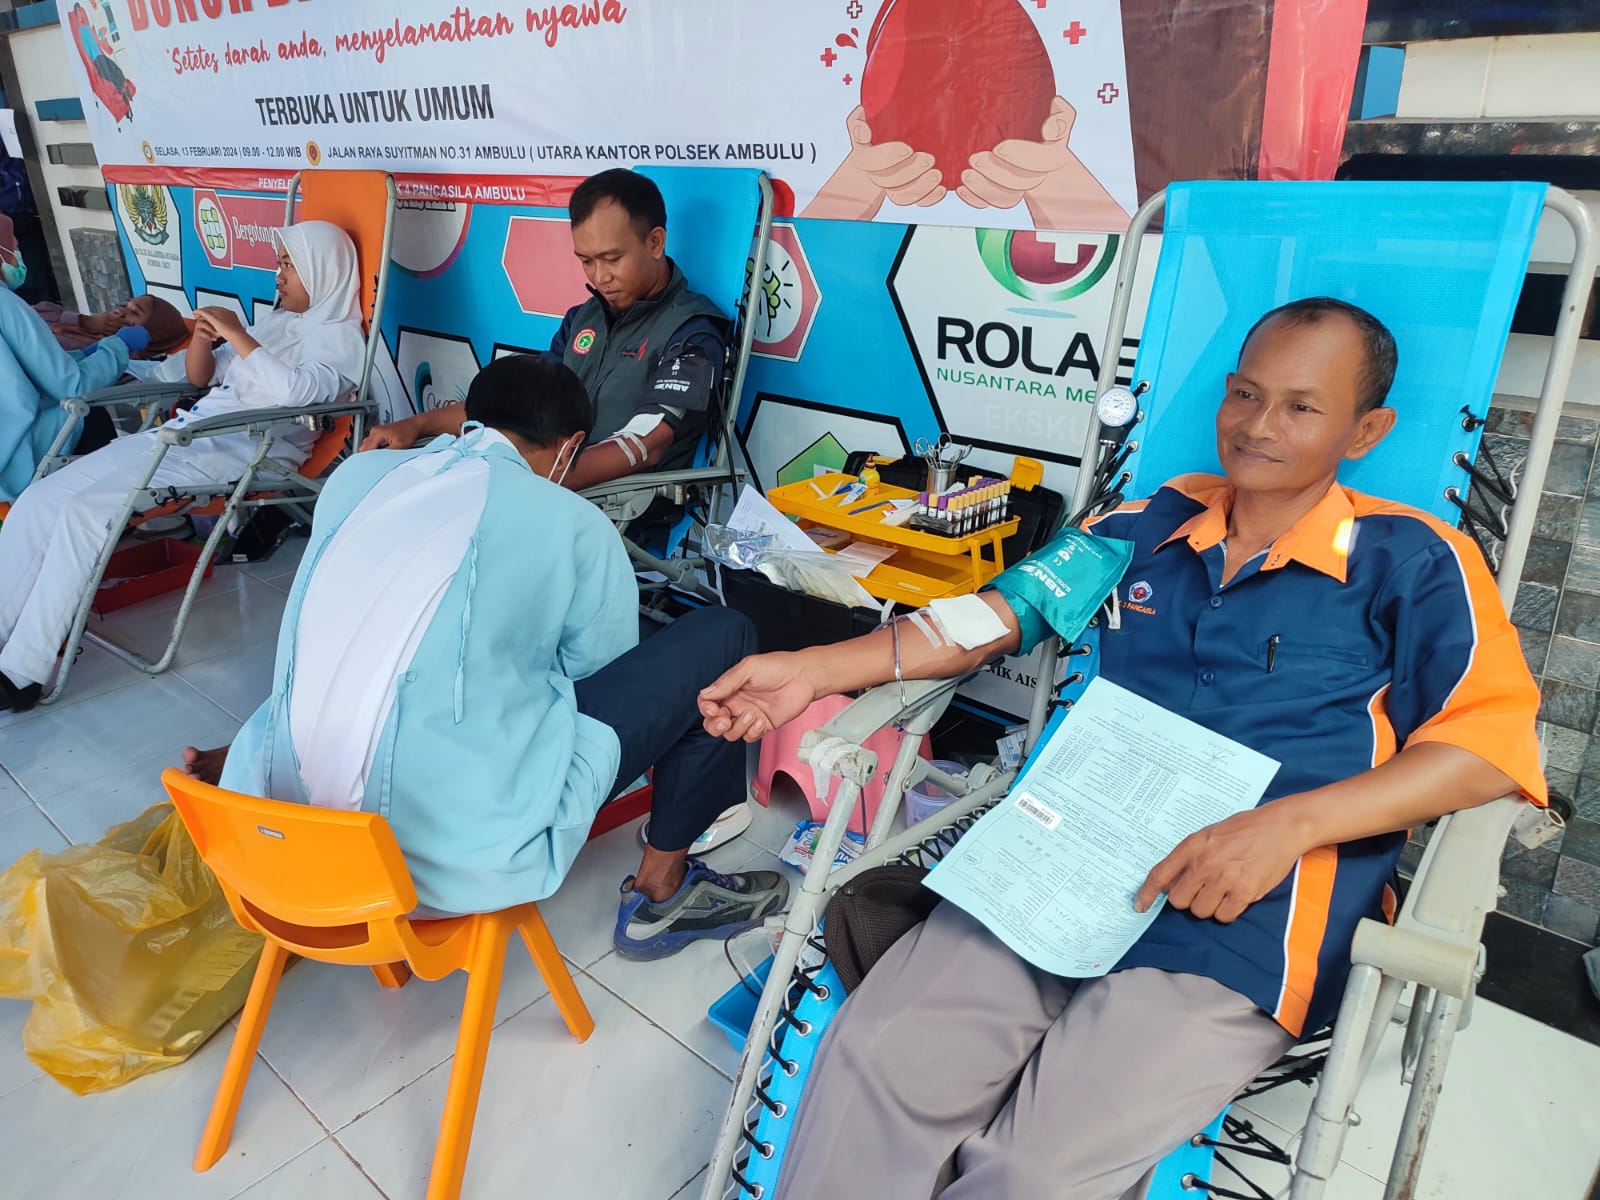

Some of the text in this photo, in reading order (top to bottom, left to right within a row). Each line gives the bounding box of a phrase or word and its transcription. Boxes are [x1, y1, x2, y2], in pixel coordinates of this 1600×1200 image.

[225, 39, 271, 67] darah
[277, 30, 327, 60] anda,
[335, 6, 514, 64] menyelamatkan
[526, 0, 627, 48] nyawa
[255, 84, 495, 126] TERBUKA UNTUK UMUM
[189, 146, 221, 157] FEBRUARI
[222, 146, 238, 157] 2024
[266, 146, 285, 157] 12.00
[286, 146, 302, 157] WIB
[328, 146, 357, 159] JALAN
[358, 146, 383, 159] RAYA
[384, 146, 437, 160] SUYITMAN
[440, 146, 472, 160] NO.31
[474, 145, 526, 160] AMBULU
[537, 145, 582, 160] UTARA
[585, 145, 653, 160] KANTOR
[656, 144, 720, 160] POLSEK
[725, 143, 804, 160] AMBULU
[412, 184, 472, 198] PANCASILA
[475, 186, 526, 201] AMBULU
[937, 367, 1057, 399] NUSANTARA
